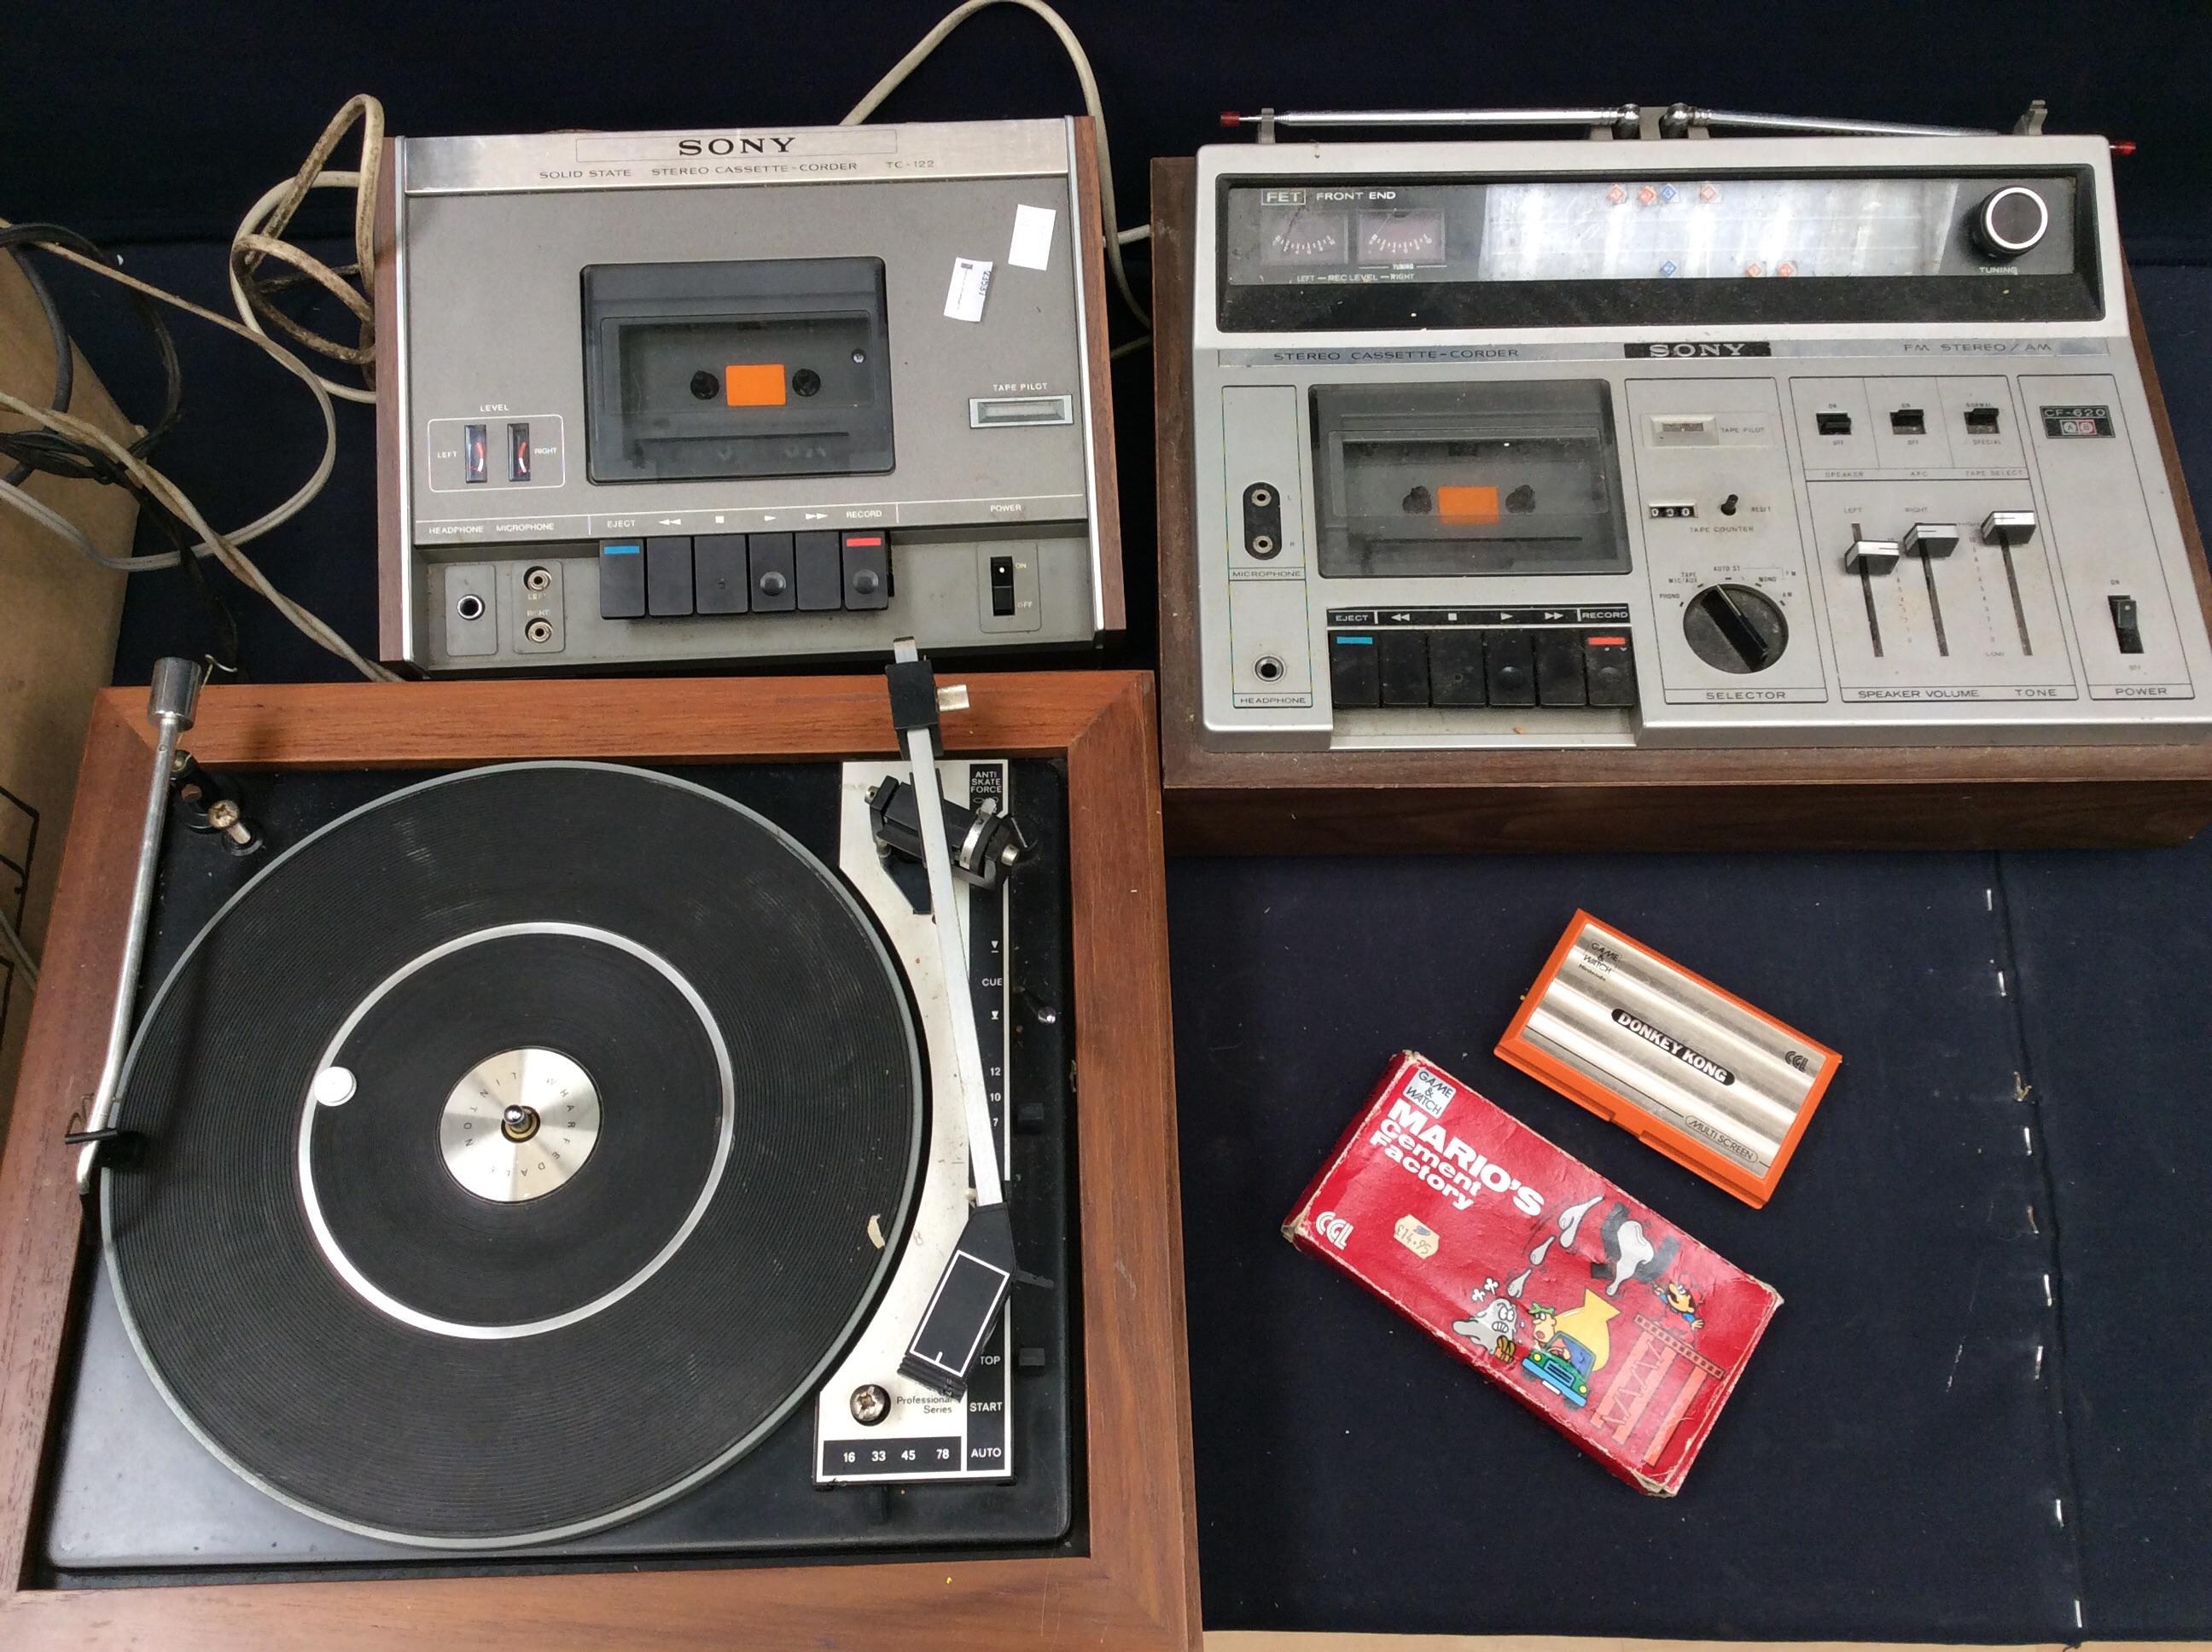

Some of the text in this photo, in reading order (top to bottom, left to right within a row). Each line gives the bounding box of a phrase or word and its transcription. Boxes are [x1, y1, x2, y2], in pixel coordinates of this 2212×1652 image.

[678, 136, 795, 156] SONY
[539, 171, 583, 179] SOLID
[589, 169, 632, 177] STATE
[651, 166, 709, 176] STEREO
[1266, 192, 1301, 202] FET
[1317, 191, 1396, 201] FRONT END
[1979, 266, 2018, 275] TUNING
[1349, 273, 1378, 282] LEVEL
[1390, 272, 1415, 281] RIGHT
[1649, 343, 1745, 357] SONY
[1273, 352, 1341, 361] STEREO
[993, 382, 1048, 392] TAPE PILOT
[2045, 409, 2105, 417] CF-620
[846, 509, 882, 519] RECORD
[496, 523, 555, 532] MICROPHONE
[607, 519, 636, 528] EJECT
[428, 526, 484, 534] HEADPHONE
[1925, 689, 1980, 698] VOLUME
[2016, 688, 2058, 697] TONE
[2115, 688, 2168, 696] POWER
[971, 777, 1001, 786] SKATE
[970, 785, 1002, 794] FORCE
[1591, 942, 1620, 962] GAME
[1583, 954, 1612, 974] WATCH
[981, 978, 1003, 986] CUE
[1617, 1012, 1728, 1083] DONKEY KONG
[1784, 1050, 1809, 1073] CGL
[990, 1067, 1001, 1076] 12
[1418, 1069, 1453, 1098] GAME
[990, 1092, 1001, 1102] 10
[1424, 1086, 1434, 1099] &
[1406, 1085, 1442, 1116] WATCH
[992, 1118, 998, 1126] 7
[1688, 1120, 1755, 1160] MULTI SCREEN
[1380, 1118, 1482, 1196] Cement
[1388, 1097, 1545, 1217] MARIO'S
[1369, 1130, 1475, 1211] Factory
[1315, 1211, 1354, 1250] CGL
[1395, 1224, 1432, 1254] £14.95
[981, 1356, 1001, 1365] TOP
[923, 1405, 952, 1414] Series
[969, 1402, 1003, 1411] START
[843, 1449, 950, 1463] 16 33 45 78
[971, 1448, 1002, 1457] AUTO
